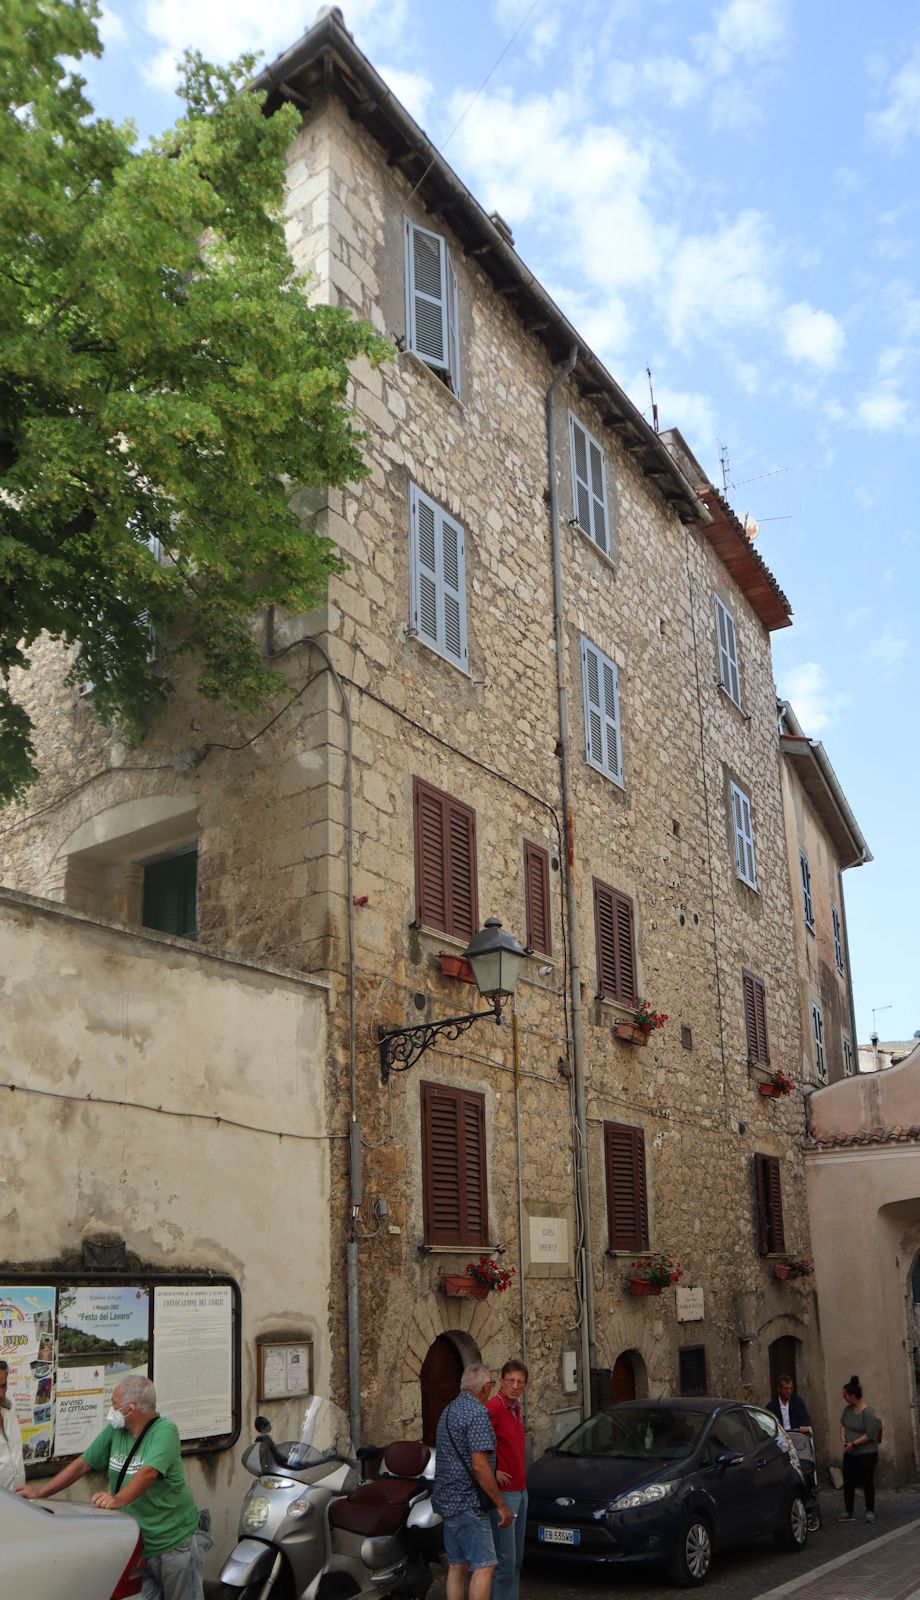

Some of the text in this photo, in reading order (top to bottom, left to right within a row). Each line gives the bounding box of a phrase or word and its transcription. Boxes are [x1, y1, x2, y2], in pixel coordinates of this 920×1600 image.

[99, 1312, 109, 1321] del
[60, 1399, 84, 1407] AVVISO
[67, 1404, 98, 1413] CITTADINI
